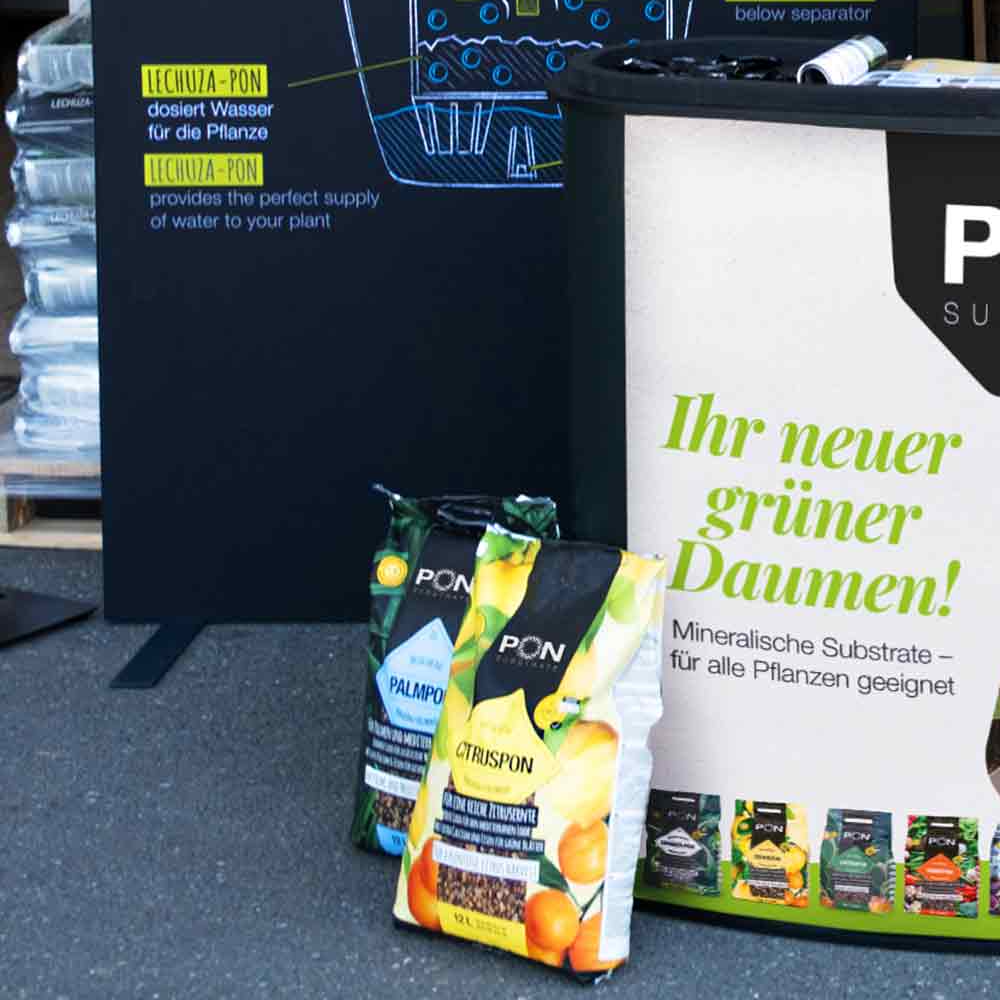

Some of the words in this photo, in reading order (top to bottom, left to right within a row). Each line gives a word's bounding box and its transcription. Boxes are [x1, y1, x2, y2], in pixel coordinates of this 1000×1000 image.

[735, 6, 786, 21] below
[792, 6, 872, 23] separator
[147, 68, 262, 94] LECHUZA-PON
[147, 101, 205, 118] dosiert
[210, 101, 273, 117] Wasser
[148, 124, 171, 141] für
[176, 124, 201, 140] die
[207, 123, 268, 141] Pflanze
[150, 157, 257, 183] LECHUZA-PON
[150, 190, 222, 208] provides
[228, 190, 254, 206] the
[260, 190, 318, 209] perfect
[323, 191, 380, 209] supply
[150, 213, 167, 228] of
[172, 214, 218, 229] water
[225, 214, 241, 229] to
[247, 215, 284, 231] your
[289, 213, 331, 230] plant
[660, 393, 766, 459] Ihr
[779, 421, 963, 475] neuer
[697, 477, 923, 545] grüner
[415, 568, 474, 593] PON
[665, 537, 961, 617] Daumen!
[499, 634, 566, 664] PON
[672, 618, 815, 656] Mineralische
[821, 636, 932, 665] Substrate
[670, 649, 700, 671] für
[707, 656, 745, 679] alle
[753, 660, 850, 689] Pflanzen
[857, 674, 955, 698] geeignet
[389, 675, 444, 704] PALMPO
